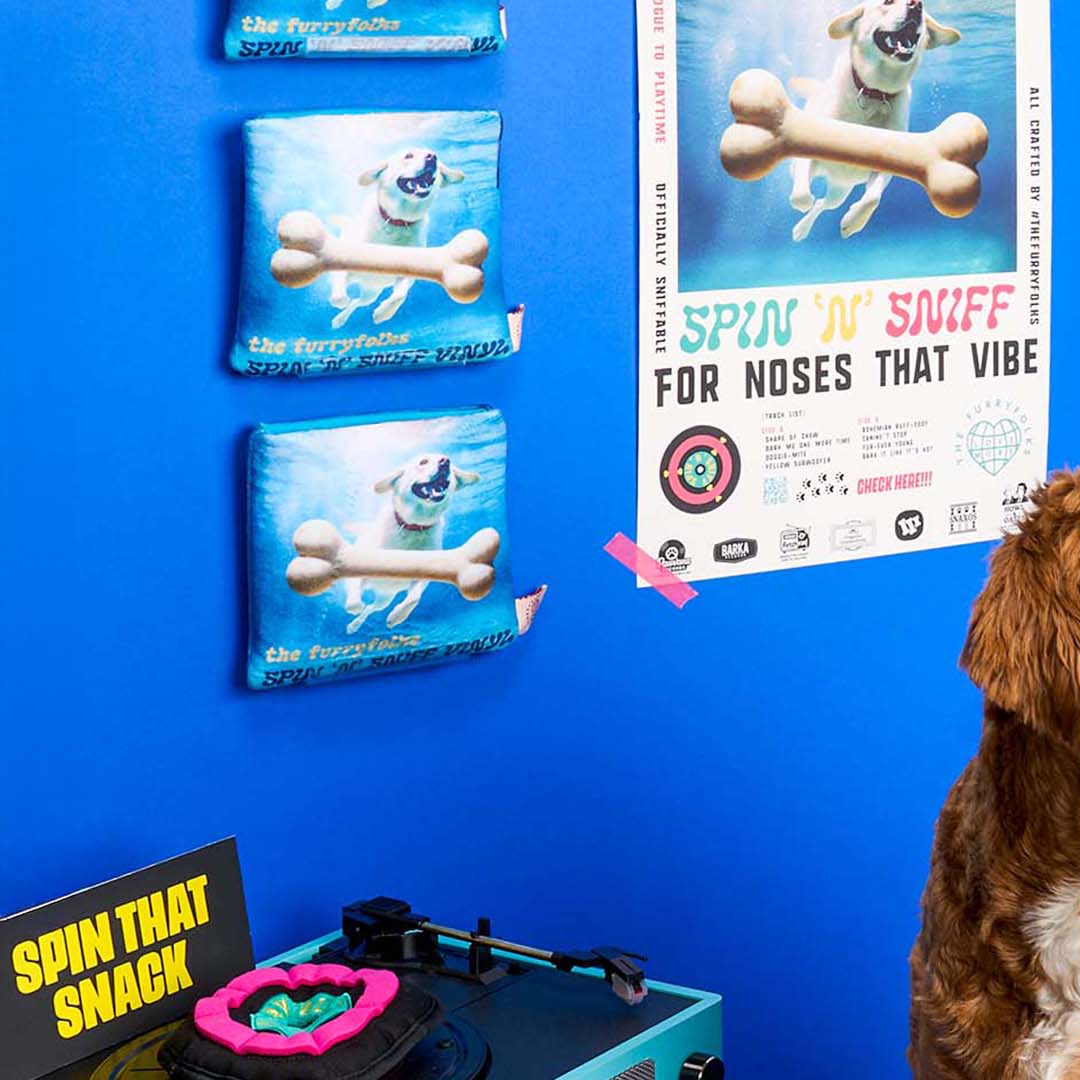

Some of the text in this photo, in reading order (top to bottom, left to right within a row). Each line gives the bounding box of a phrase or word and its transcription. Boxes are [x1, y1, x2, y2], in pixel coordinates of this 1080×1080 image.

[239, 40, 303, 57] SPIN
[241, 15, 400, 35] the furryfolks
[654, 44, 665, 60] TO
[655, 72, 666, 144] PLAYTIME
[1029, 87, 1040, 325] ALL CRAFTED BY #THEFURRYFOLKS
[656, 183, 666, 353] OFFICIALLY SNIFFABLE
[247, 331, 411, 354] the furryfolks
[680, 298, 798, 354] SPIN
[885, 284, 1016, 338] SNIFF
[654, 338, 1038, 408] FOR NOSES THAT VIBE
[857, 471, 933, 495] CHECK HERE!!!
[722, 541, 750, 557] BARKA
[265, 635, 421, 663] the furryfolks
[12, 873, 210, 995] SPIN THAT
[53, 939, 194, 1039] SNACK
